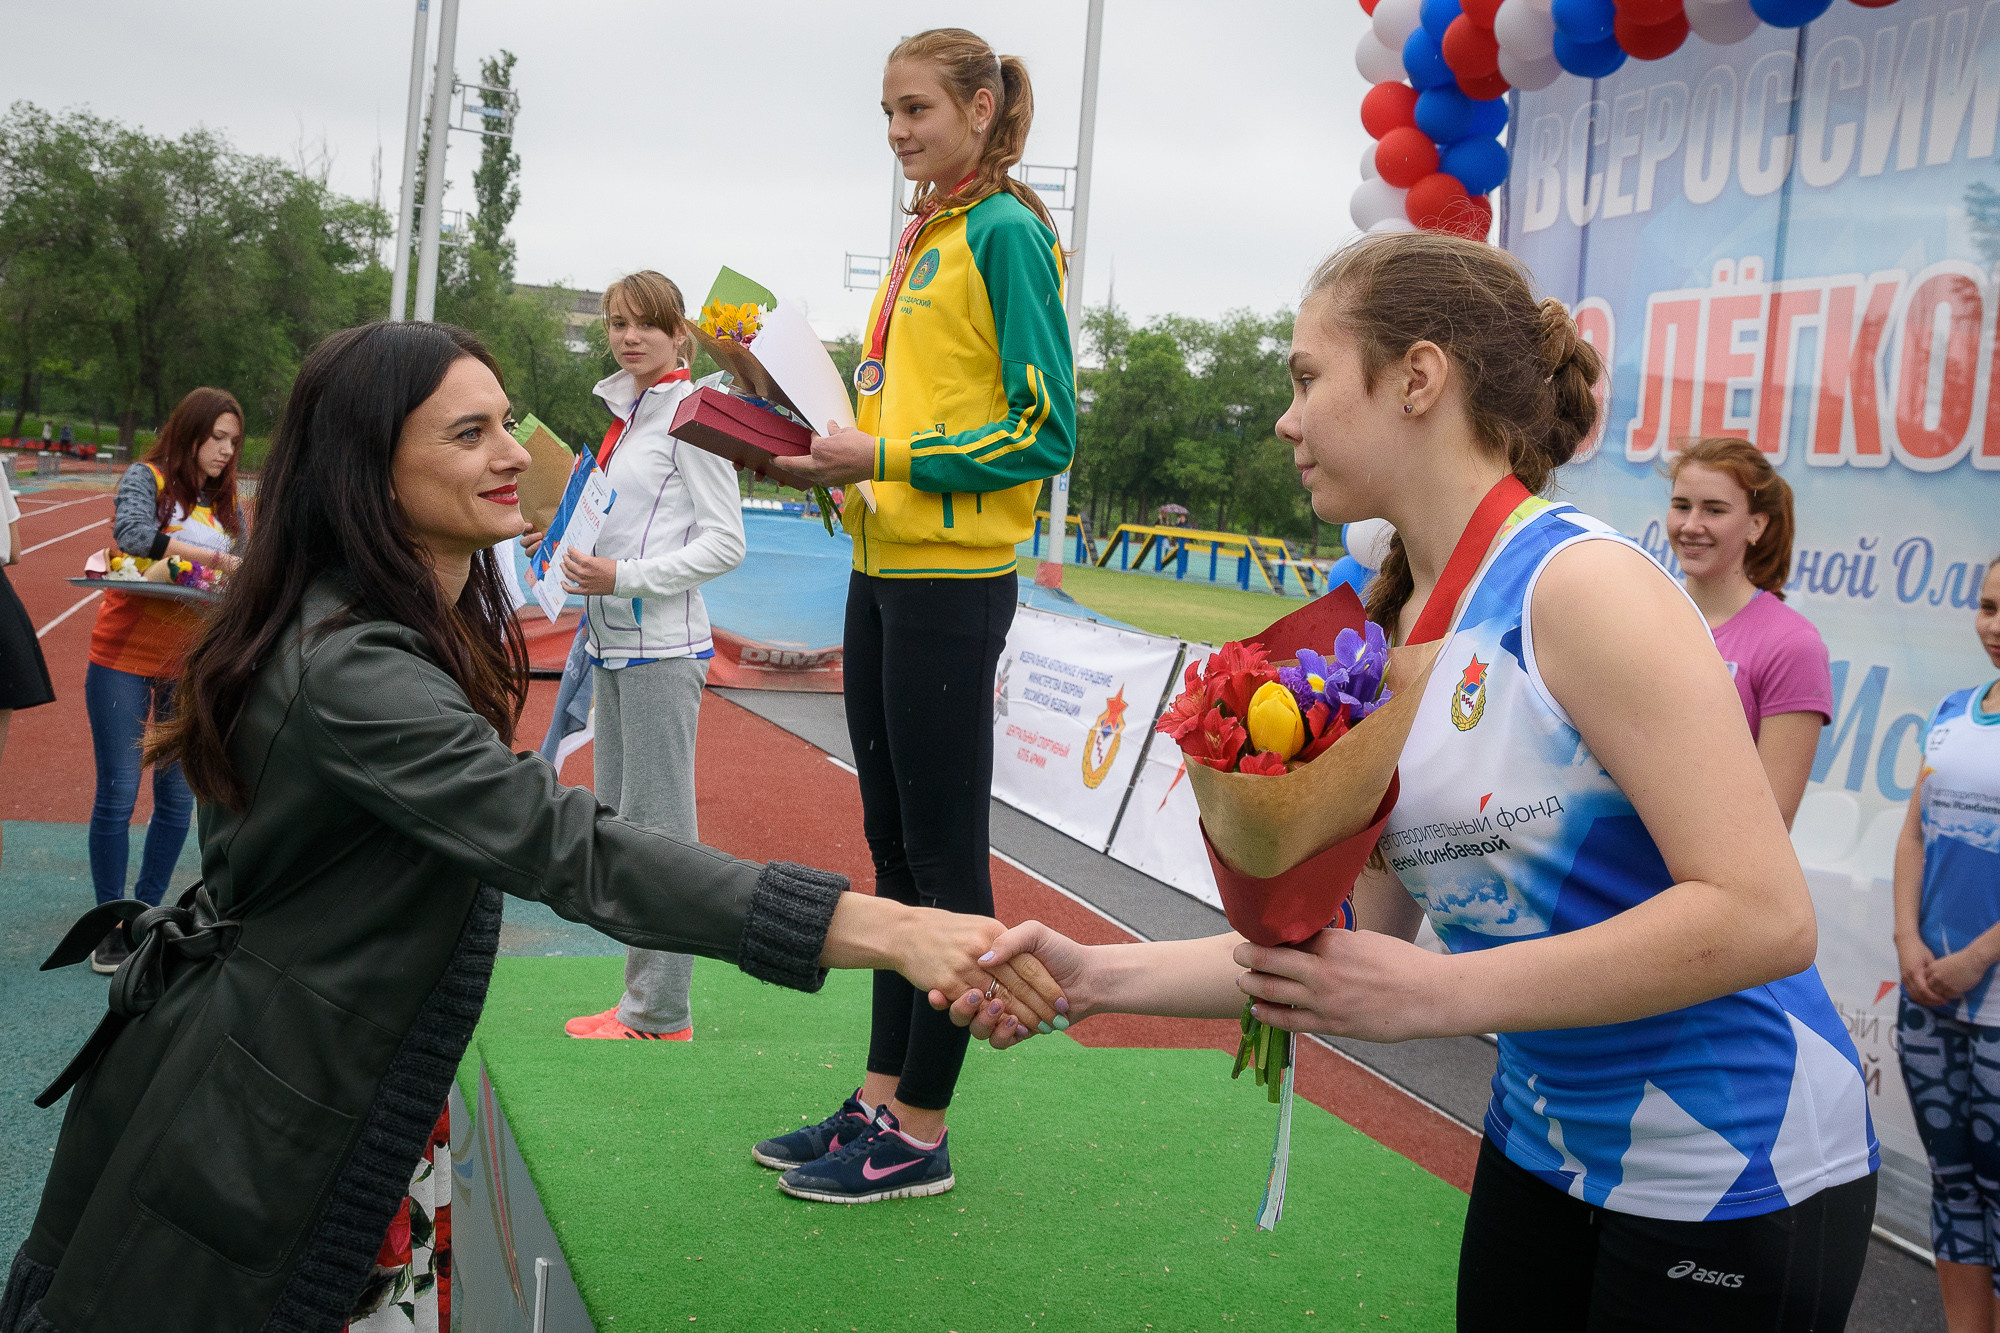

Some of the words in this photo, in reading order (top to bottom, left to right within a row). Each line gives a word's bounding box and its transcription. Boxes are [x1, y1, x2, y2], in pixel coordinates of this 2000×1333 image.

[1626, 256, 2000, 472] ЛЁГКО
[1496, 796, 1564, 831] фонд
[1413, 834, 1511, 867] Исинбаевой
[1691, 1267, 1745, 1288] asics
